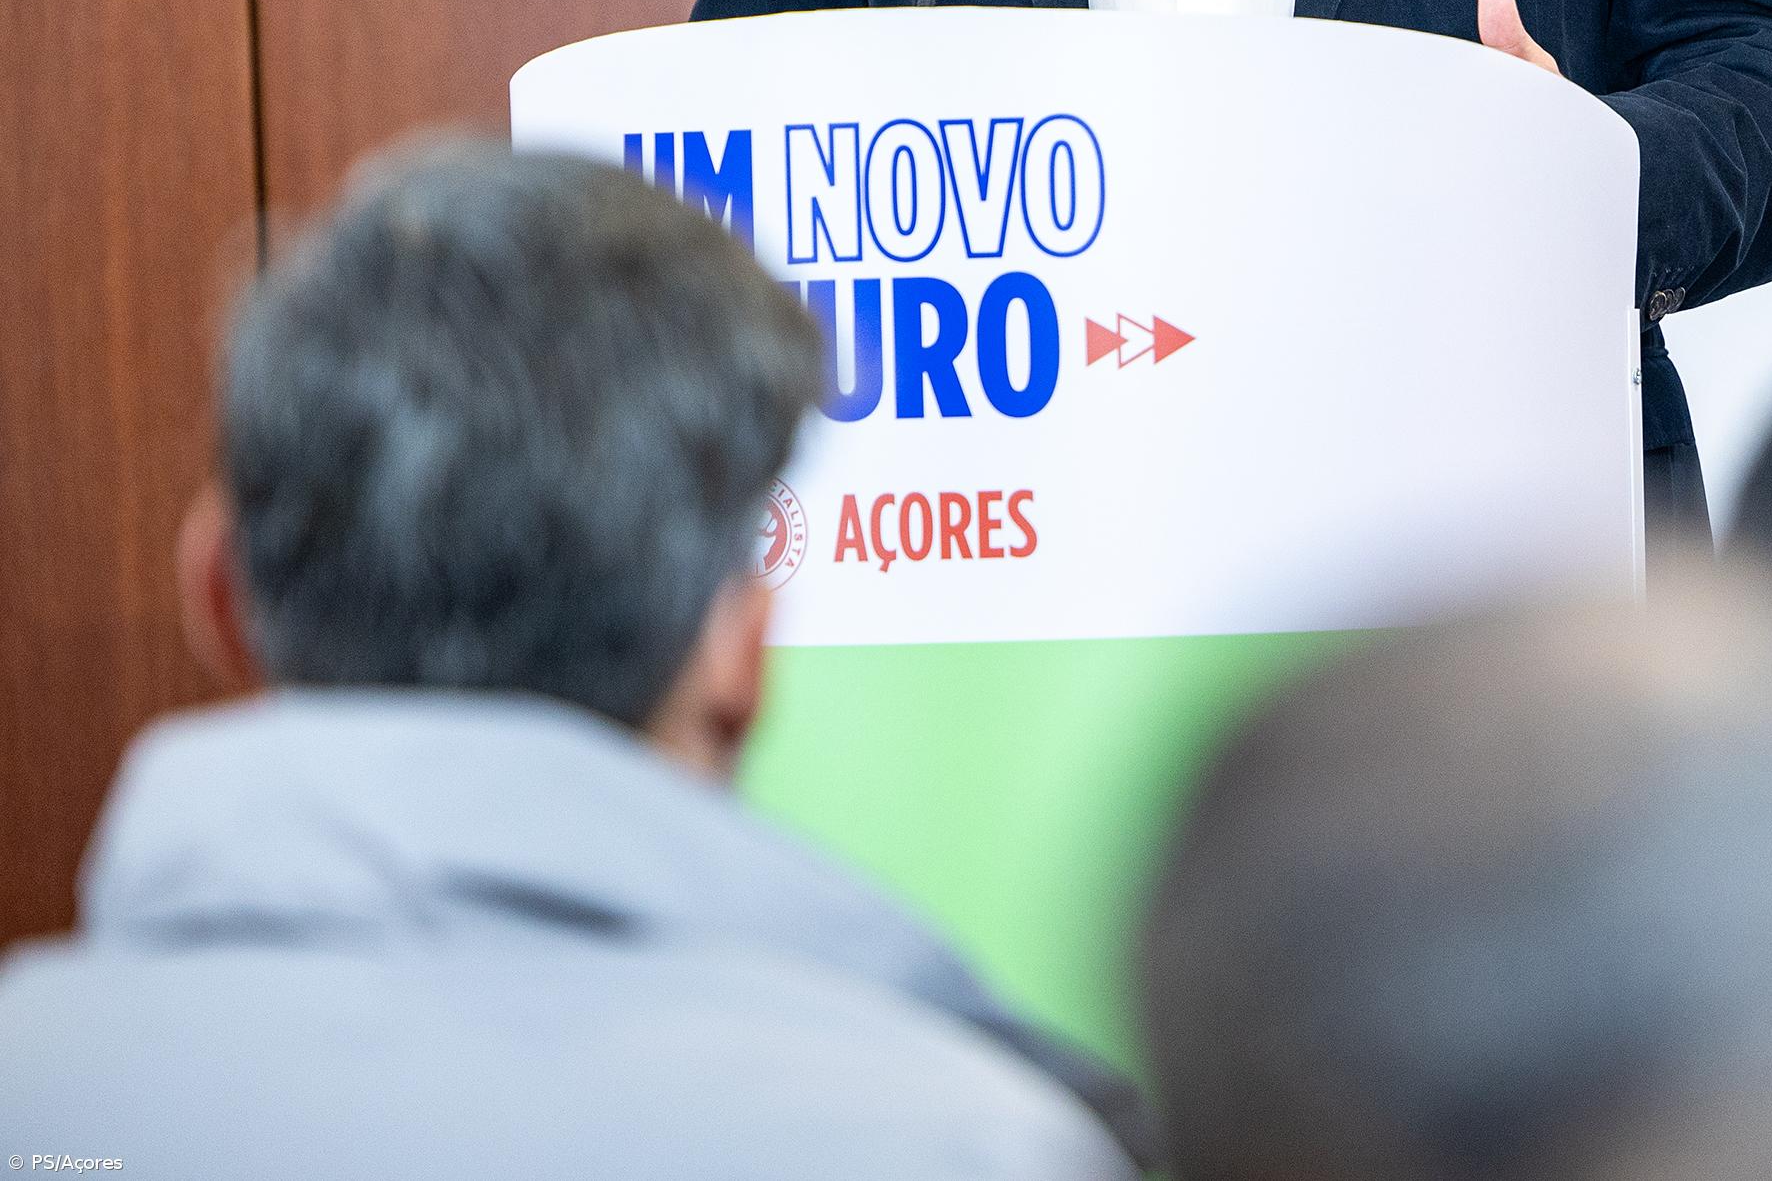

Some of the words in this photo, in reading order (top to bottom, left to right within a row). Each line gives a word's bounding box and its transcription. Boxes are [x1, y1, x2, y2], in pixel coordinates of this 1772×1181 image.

[785, 113, 1106, 265] NOVO
[779, 271, 1060, 423] URO
[768, 480, 804, 569] CIALISTA
[834, 488, 1038, 573] AÇORES
